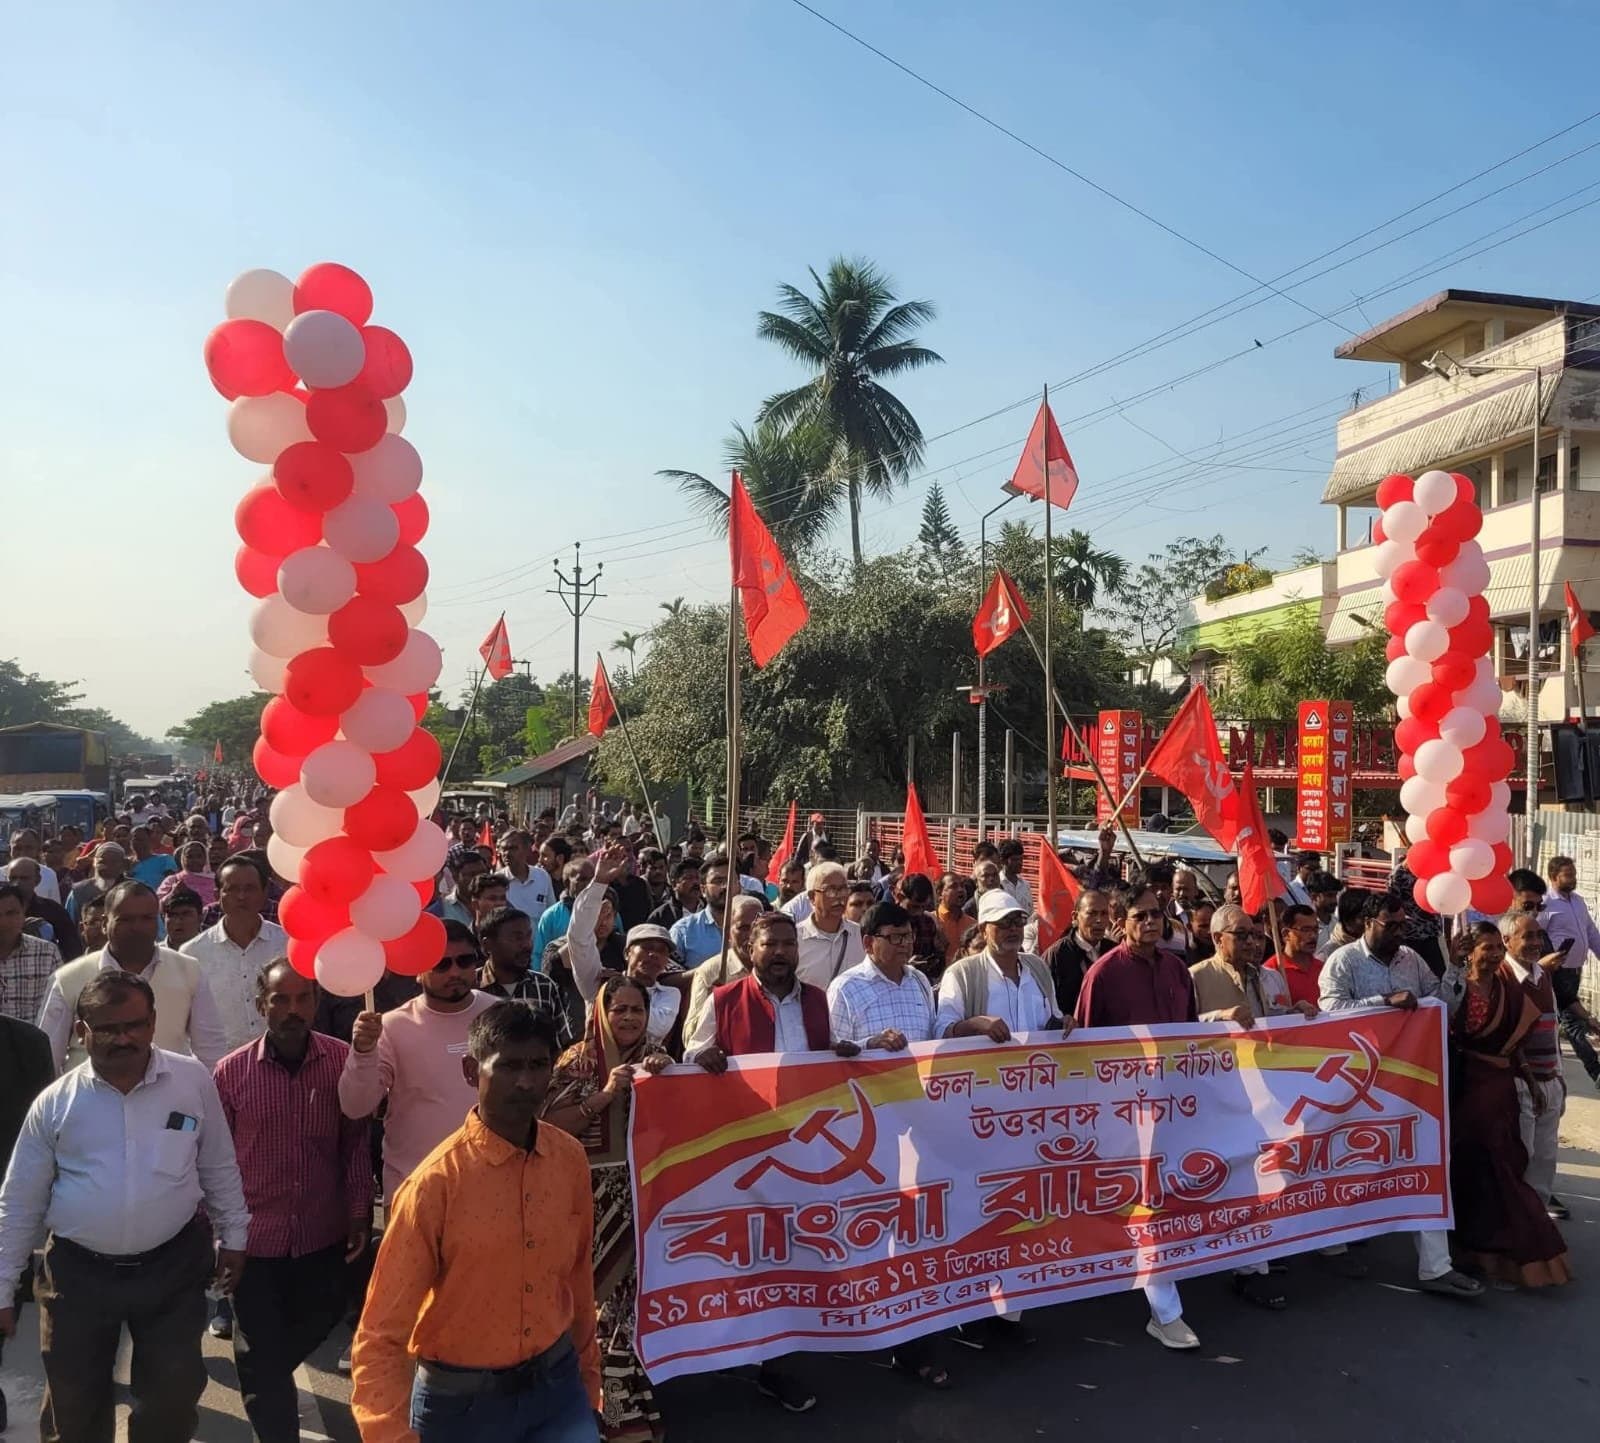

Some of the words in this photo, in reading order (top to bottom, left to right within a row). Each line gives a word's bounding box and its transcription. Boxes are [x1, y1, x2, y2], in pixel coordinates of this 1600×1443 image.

[1301, 809, 1323, 818] GEMS
[999, 1052, 1058, 1093] জমি
[1094, 1055, 1167, 1086] জঙ্গল
[1173, 1042, 1234, 1080] বাঁচাও
[968, 1101, 1101, 1140] উত্তরবঙ্গ
[1112, 1088, 1198, 1126] বাঁচাও
[660, 1179, 951, 1269] বাংলা
[975, 1134, 1230, 1224] বাঁচাও
[1257, 1113, 1420, 1179] যাত্রা
[1123, 1212, 1202, 1248] তুফানগঞ্জ
[1208, 1204, 1251, 1230] থেকে
[1333, 1169, 1430, 1205] (কোলকাতা)
[647, 1294, 688, 1327] ২৯
[699, 1288, 727, 1318] শে
[735, 1282, 819, 1309] নভেম্বর
[827, 1275, 880, 1305] থেকে
[887, 1261, 917, 1292] ১৭
[922, 1254, 939, 1284] ই
[944, 1243, 1010, 1279] ডিসেম্বর
[1019, 1236, 1073, 1262] ২০২৫
[1017, 1254, 1136, 1285] পশ্চিমবঙ্গ
[1146, 1240, 1196, 1267] রাজ্য
[1204, 1223, 1274, 1252] কমিটি
